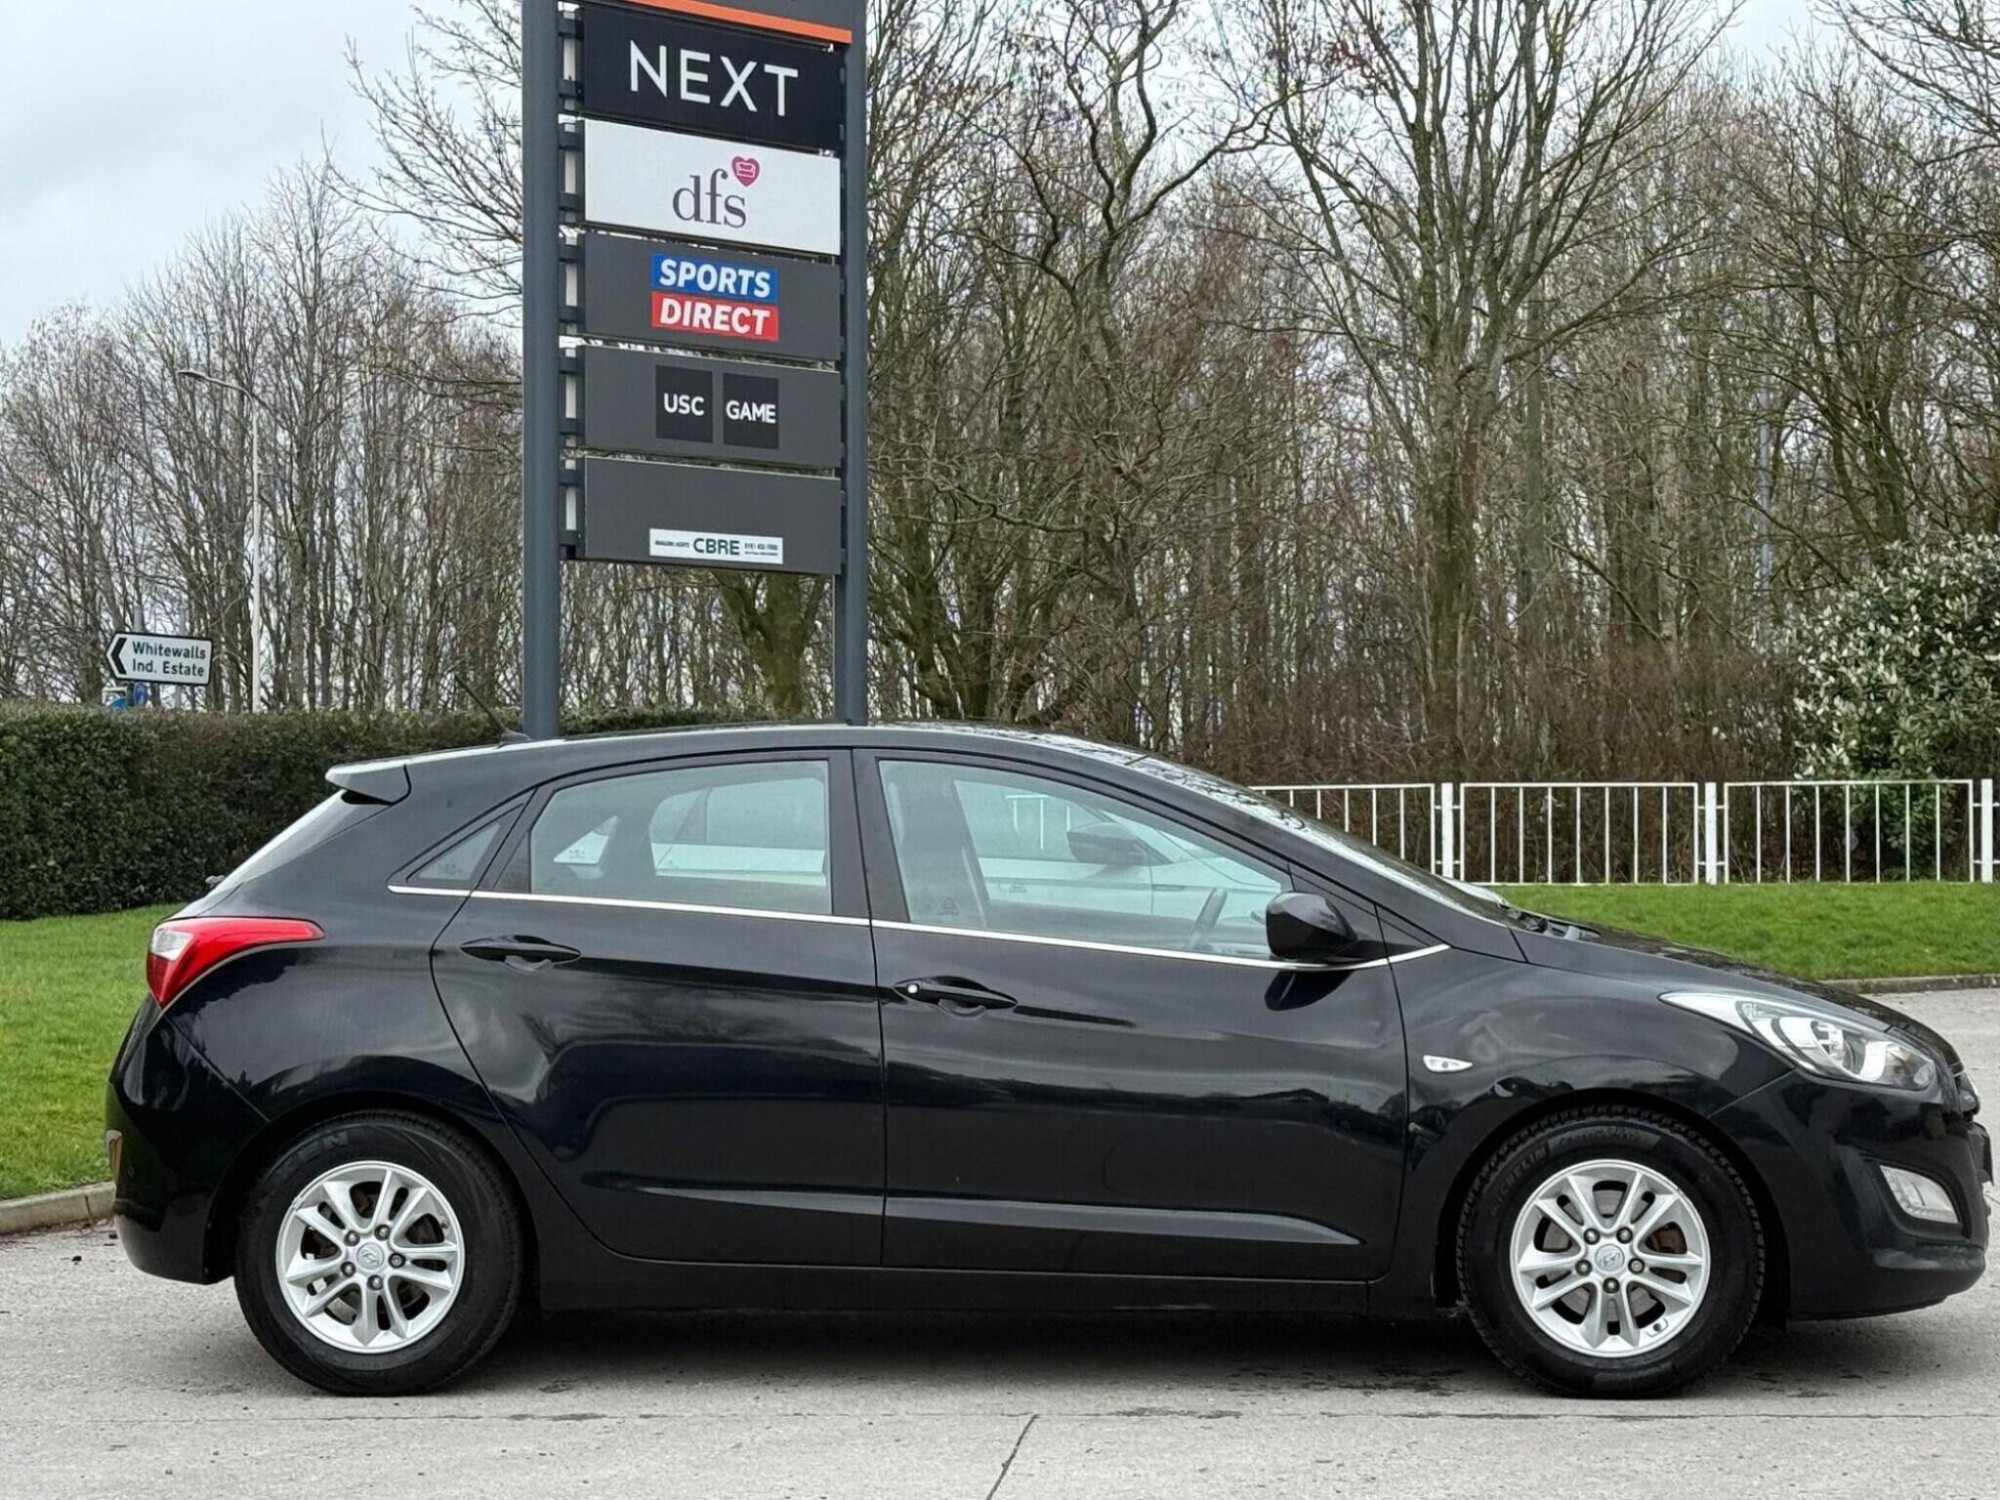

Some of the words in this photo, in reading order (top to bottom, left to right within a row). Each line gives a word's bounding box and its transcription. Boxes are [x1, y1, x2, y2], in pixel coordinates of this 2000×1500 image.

[630, 39, 799, 117] NEXT
[672, 168, 748, 229] dfs
[659, 258, 771, 298] SPORTS
[660, 297, 771, 336] DIRECT
[663, 392, 705, 416] USC
[725, 400, 776, 424] GAME
[693, 537, 740, 556] CBRE
[132, 641, 206, 660] Whitewalls
[132, 658, 157, 674] Ind.
[162, 661, 205, 677] Estate
